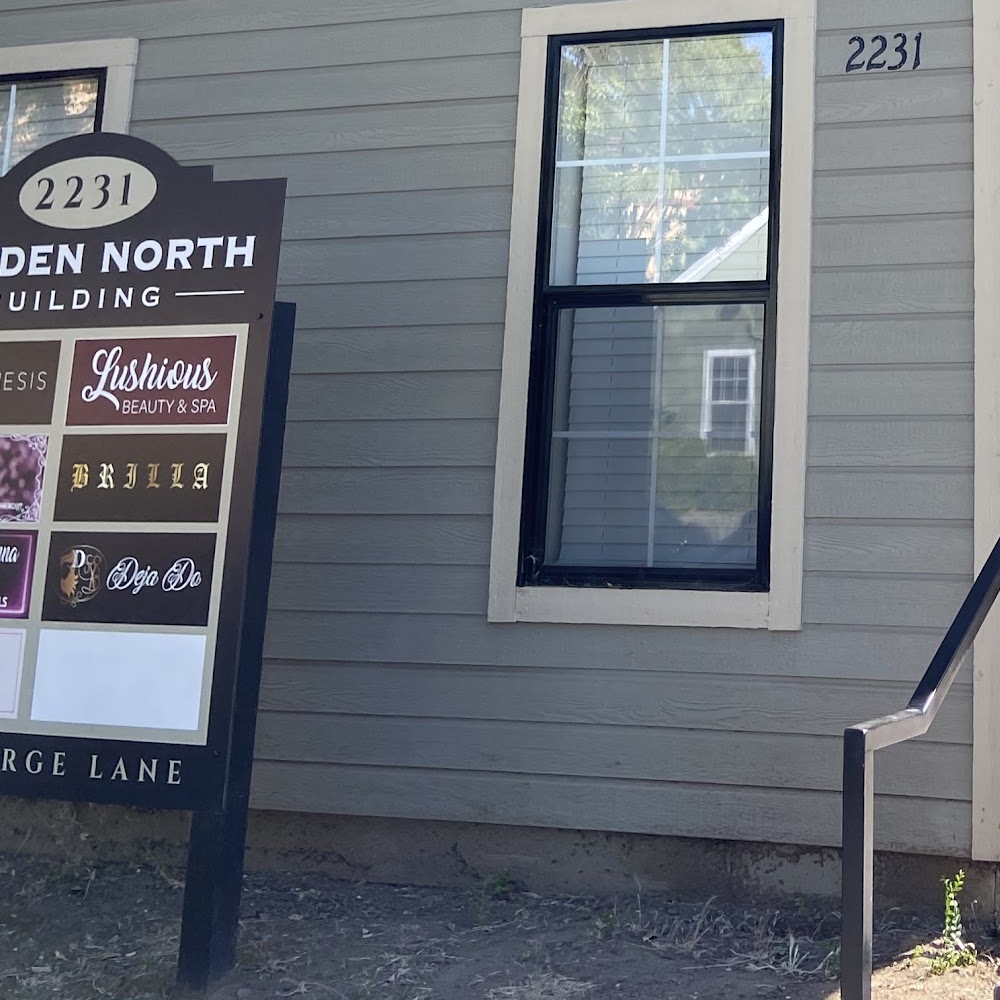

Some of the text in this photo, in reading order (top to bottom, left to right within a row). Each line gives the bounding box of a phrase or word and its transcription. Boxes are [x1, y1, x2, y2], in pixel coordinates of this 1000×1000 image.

[845, 32, 922, 73] 2231
[34, 172, 132, 210] 2231
[0, 235, 257, 277] DEN NORTH
[8, 286, 161, 312] UILDING
[0, 371, 48, 391] ESIS
[82, 346, 218, 411] Lushious
[122, 398, 217, 415] BEAUTY & SPA
[70, 462, 211, 492] BRILLA
[106, 556, 202, 595] Deja Do
[1, 748, 184, 785] RGE LANE
